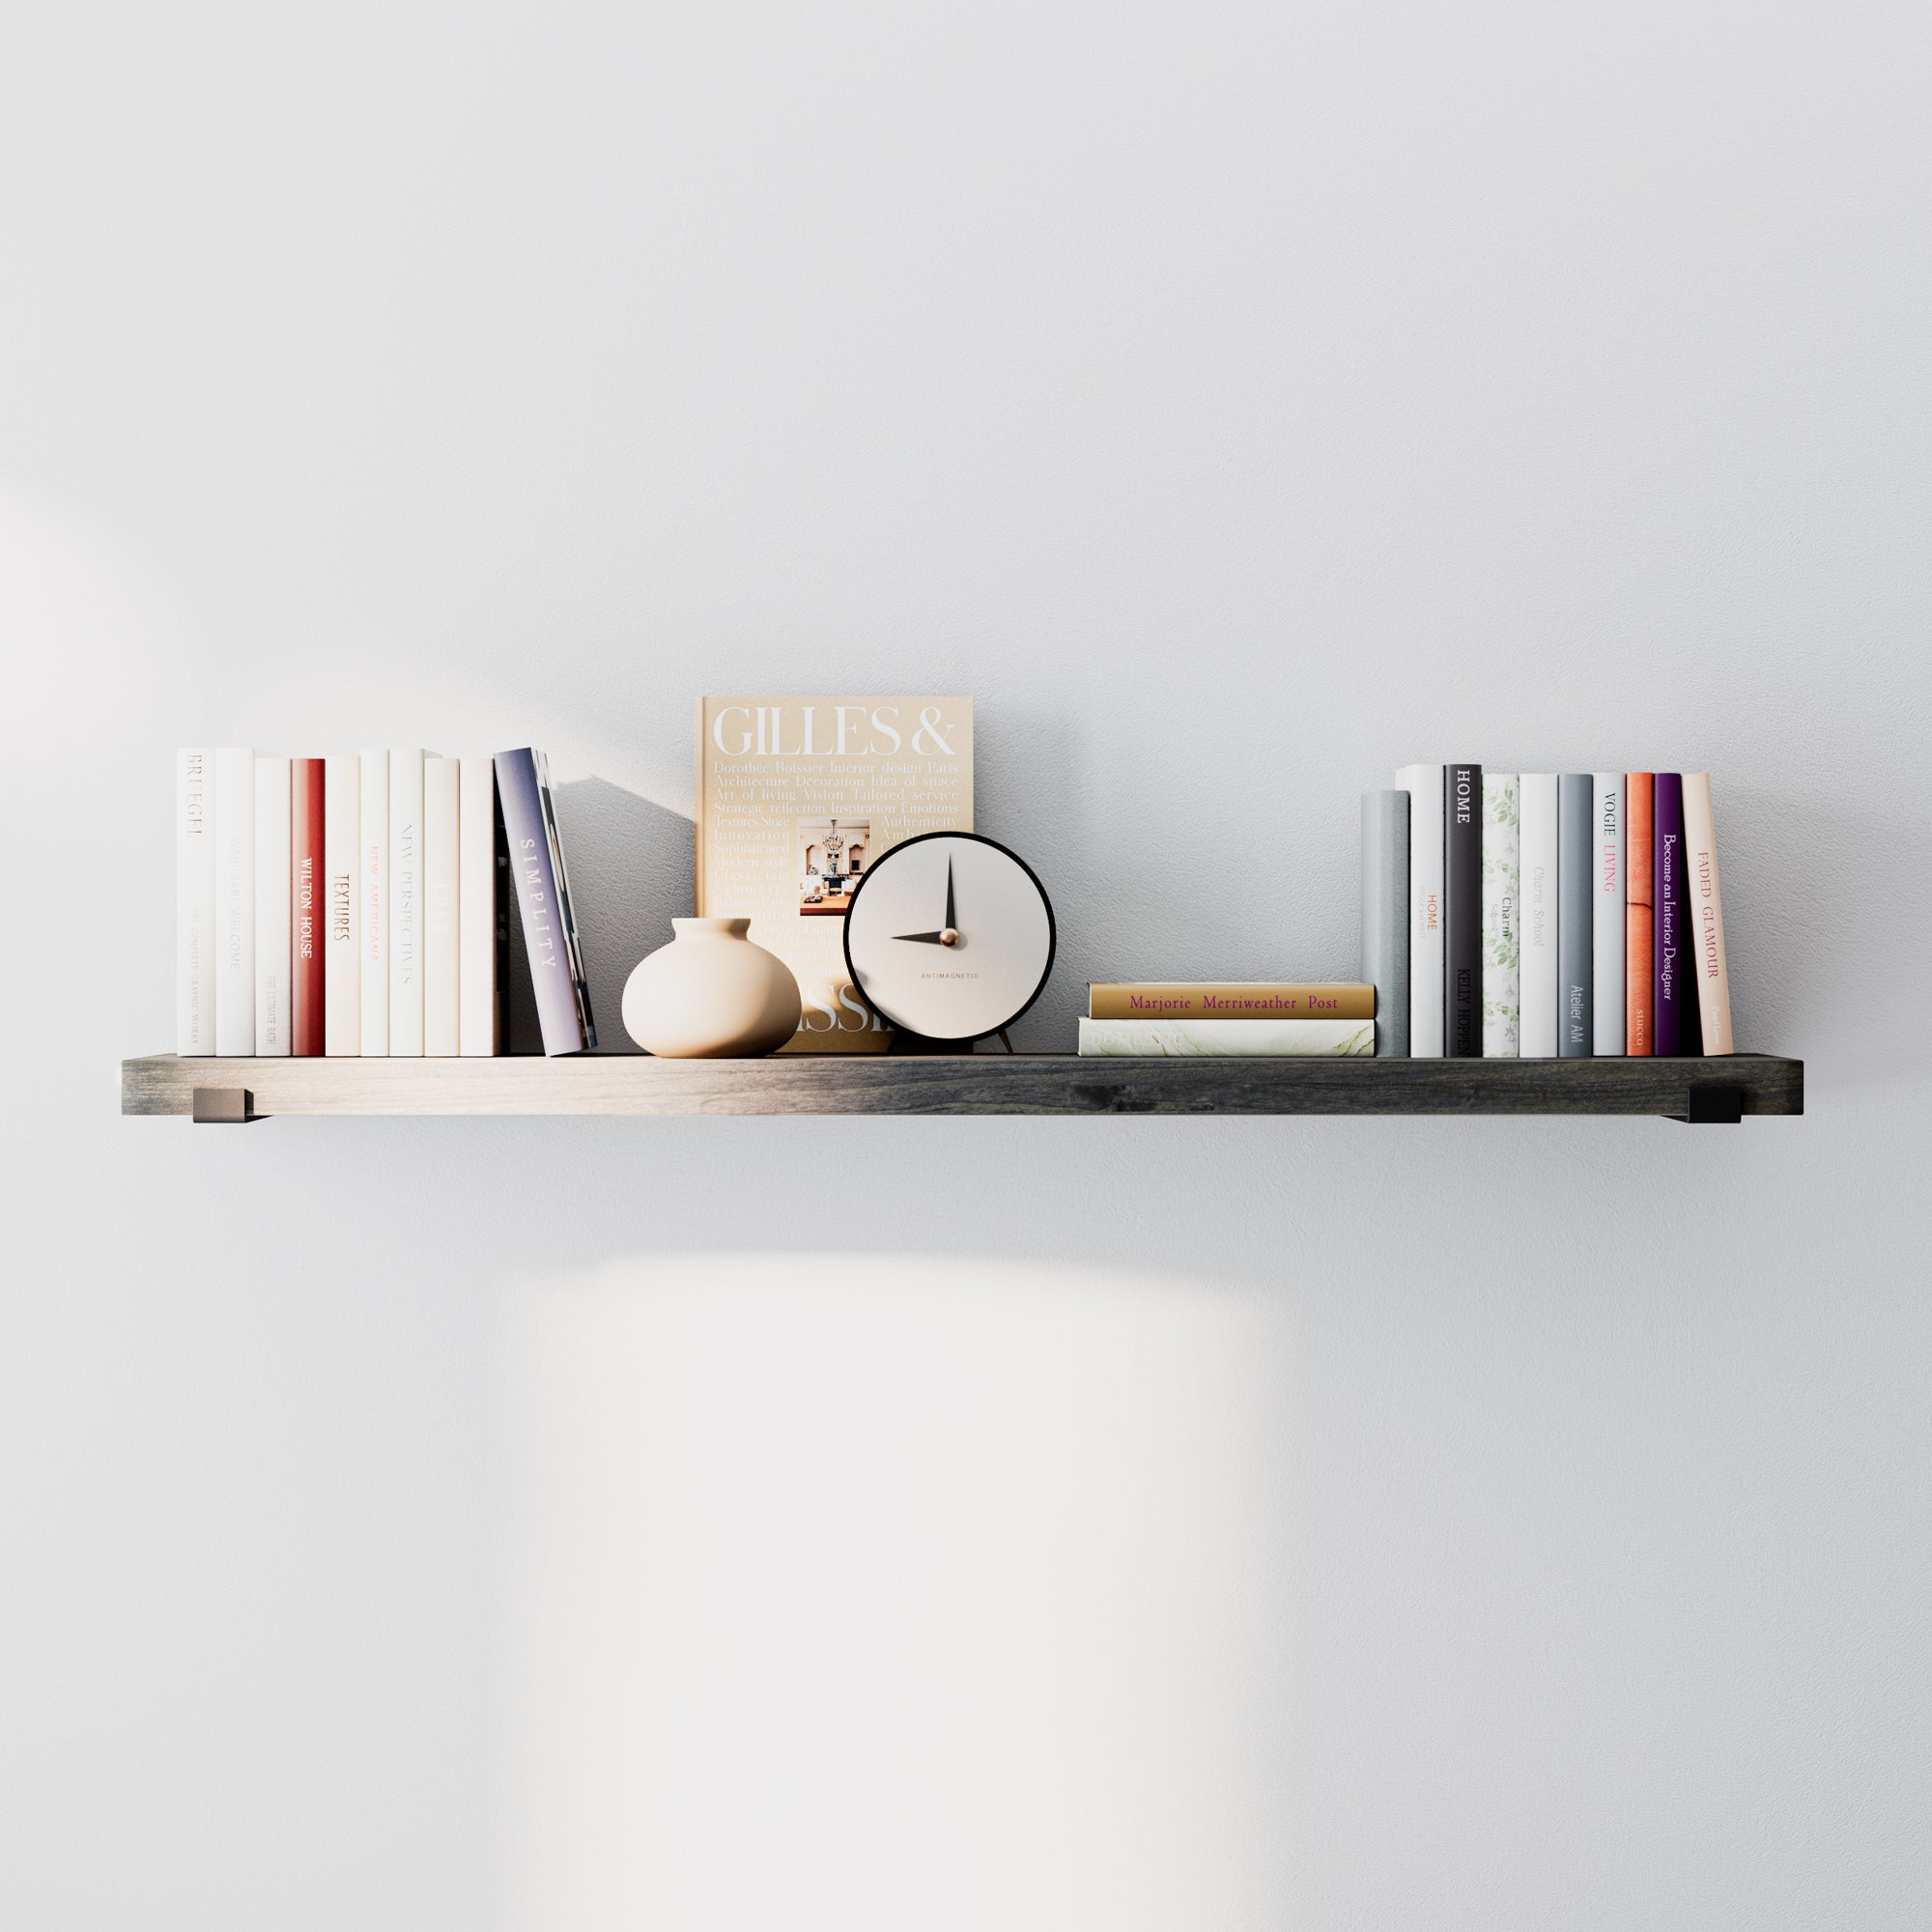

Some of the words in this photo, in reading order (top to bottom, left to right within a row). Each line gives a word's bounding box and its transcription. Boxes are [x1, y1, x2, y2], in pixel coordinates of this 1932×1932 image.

[713, 706, 901, 756] GILLES
[911, 706, 956, 756] &
[714, 775, 789, 787] Architecture
[871, 775, 897, 787] Idea
[904, 775, 917, 787] of
[923, 778, 958, 789] space
[776, 760, 823, 774] Boissier
[830, 760, 875, 774] Interior
[881, 760, 921, 775] design
[927, 760, 958, 774] Paris
[713, 801, 764, 815] Strategic
[770, 801, 827, 814] reflection
[831, 801, 897, 815] Inspiration
[901, 801, 958, 814] Emotions
[714, 787, 734, 801] Art
[742, 787, 755, 801] of
[762, 787, 797, 802] living
[804, 787, 843, 801] Vision
[852, 787, 905, 801] Tailored
[913, 789, 958, 801] service
[1457, 769, 1471, 824] HOME
[714, 813, 759, 828] Textures
[760, 814, 790, 828] Store
[880, 814, 958, 829] Authenticity
[370, 845, 380, 875] NEW
[1604, 844, 1616, 893] LIVING
[1663, 834, 1677, 882] Become
[1697, 851, 1713, 898] FADED
[300, 857, 313, 910] WILTON
[520, 838, 556, 968] SIMPLITY
[1663, 884, 1673, 898] an
[333, 873, 351, 942] TEXTURES
[370, 884, 380, 962] AMERICANA
[1427, 894, 1438, 931] HOME
[1501, 896, 1513, 938] Charm
[1663, 900, 1677, 945] Interior
[300, 916, 313, 959] HOUSE
[1532, 909, 1546, 948] School
[1702, 905, 1719, 979] GLAMOUR
[1457, 968, 1471, 1005] KELLY
[1661, 947, 1677, 1001] Designer
[1129, 995, 1191, 1012] Marjorie
[1203, 995, 1297, 1009] Merriweather
[1308, 995, 1338, 1009] Post
[1570, 984, 1584, 1020] Atelier
[1457, 1009, 1471, 1056] HOPPEN
[1570, 1024, 1584, 1043] AM
[1636, 1009, 1645, 1046] stucco
